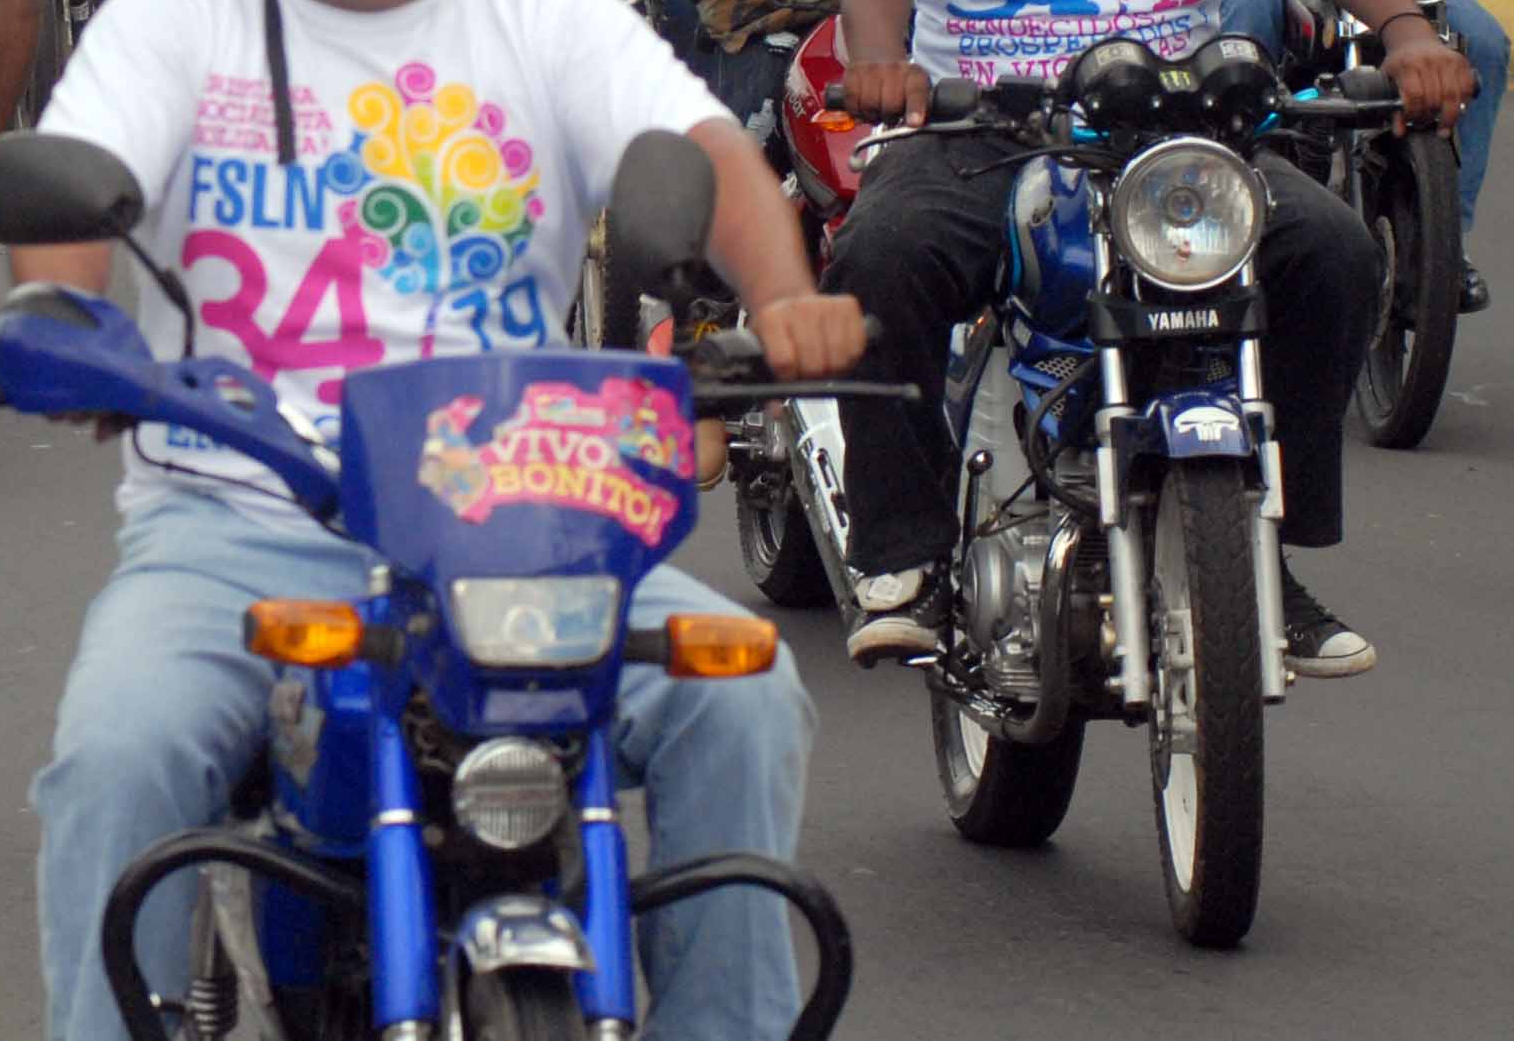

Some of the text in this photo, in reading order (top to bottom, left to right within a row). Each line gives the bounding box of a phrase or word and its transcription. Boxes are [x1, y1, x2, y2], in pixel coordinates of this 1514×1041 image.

[189, 153, 327, 231] FSLN
[182, 229, 385, 404] 34
[1148, 309, 1219, 330] YAMAHA
[493, 430, 614, 470] VIVO
[489, 462, 663, 534] BONITO!
